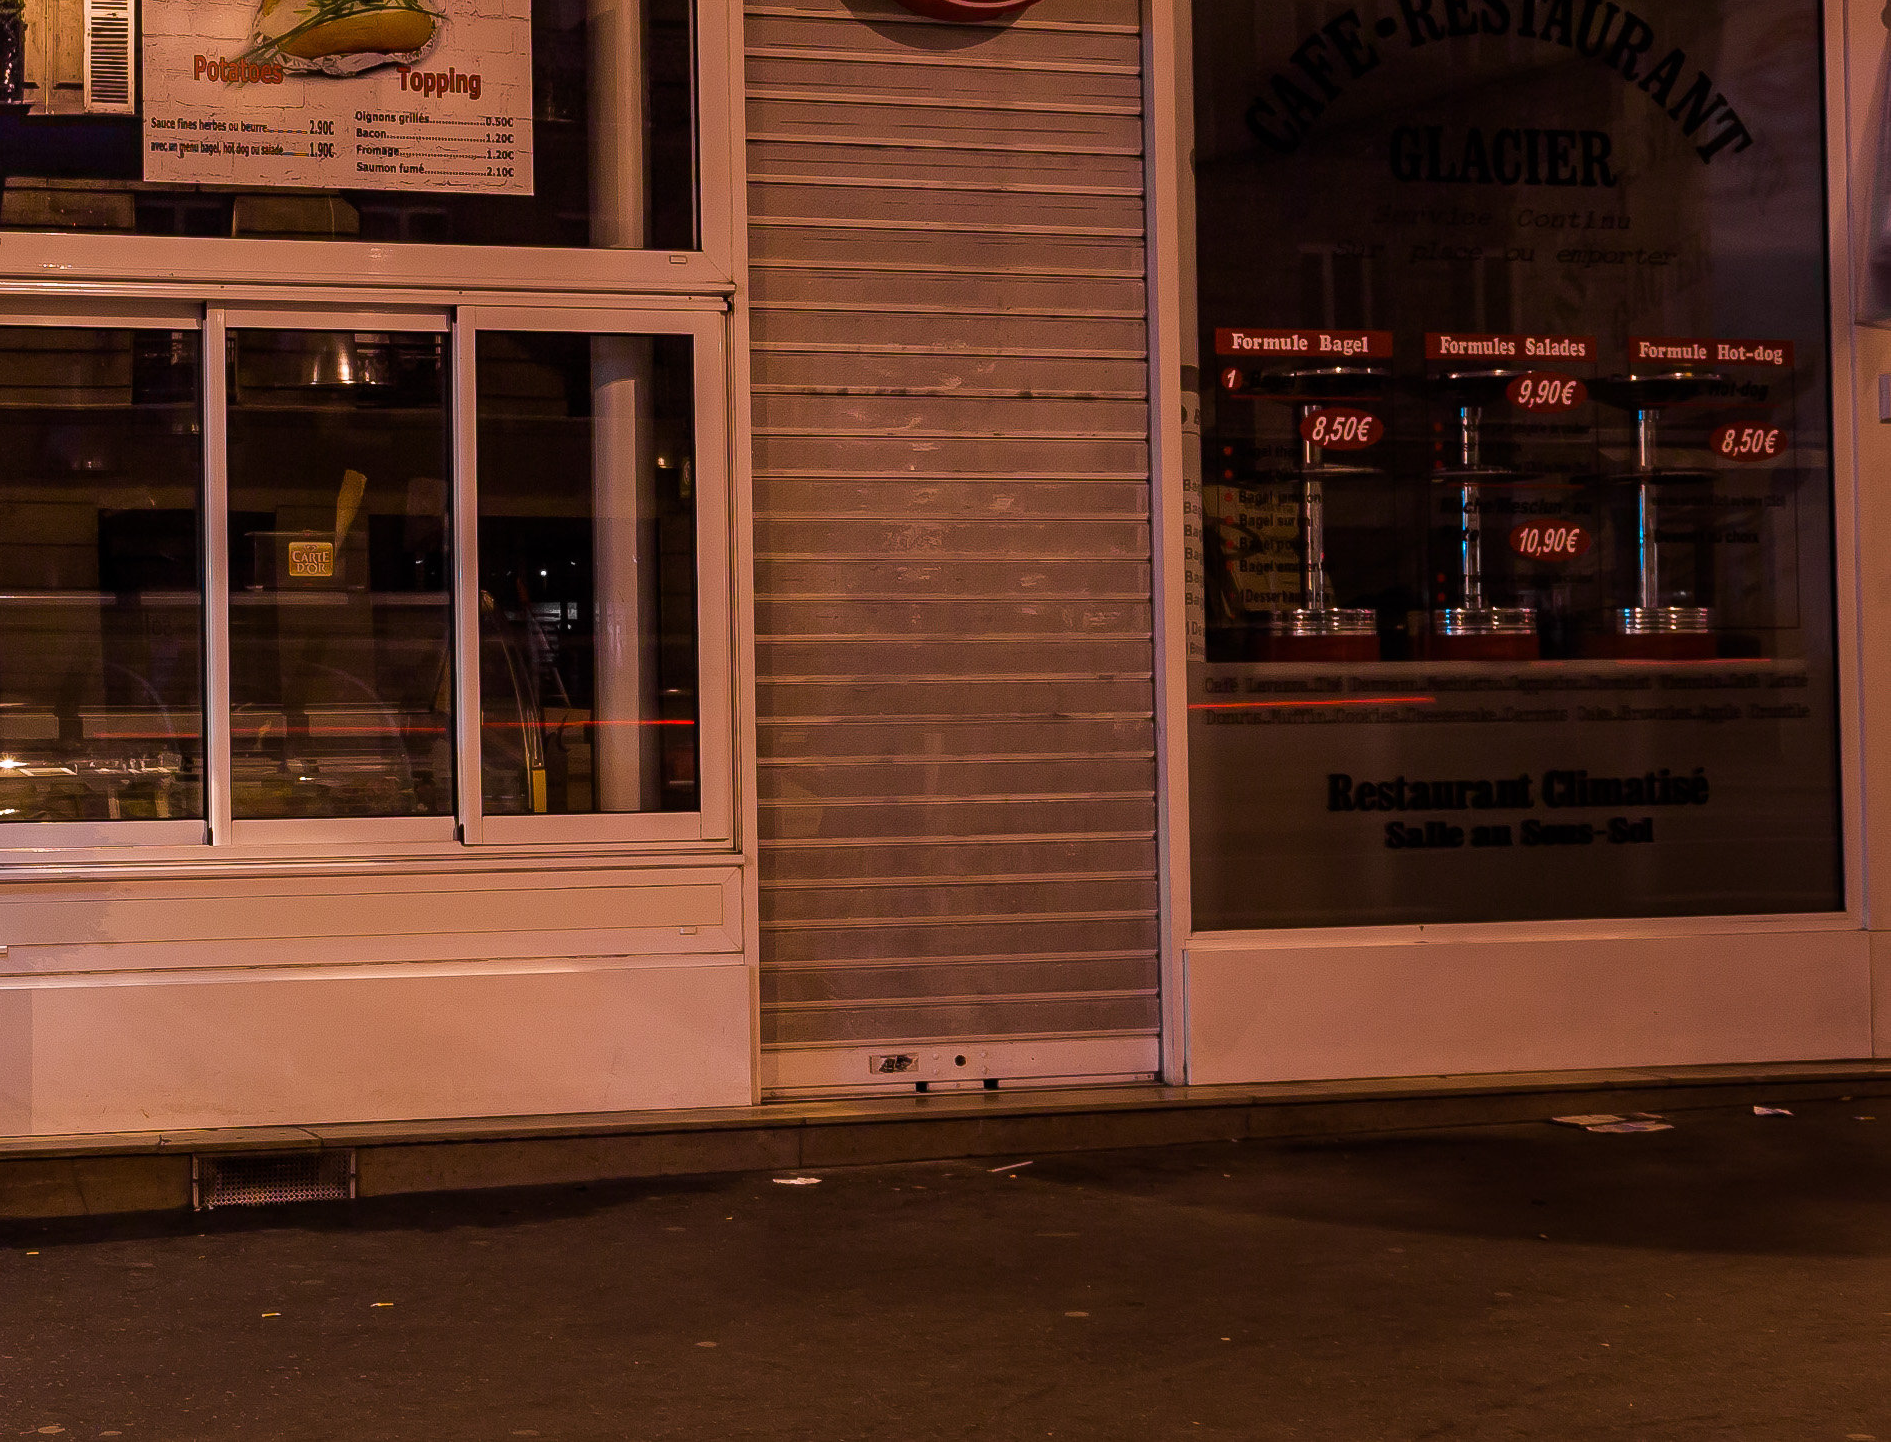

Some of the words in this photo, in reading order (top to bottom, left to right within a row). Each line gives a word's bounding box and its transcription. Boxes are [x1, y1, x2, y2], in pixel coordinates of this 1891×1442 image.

[194, 54, 284, 84] Potatoes
[396, 66, 482, 100] Topping
[151, 117, 175, 129] Sauce
[177, 118, 197, 130] fines
[199, 119, 226, 131] herbes
[229, 122, 239, 131] ou
[355, 111, 396, 124] Oignons
[356, 128, 386, 139] Bacon
[357, 145, 399, 157] Fromage
[1389, 125, 1617, 187] GLACIER
[356, 162, 396, 174] Saumon
[1373, 205, 1494, 227] Service
[1517, 208, 1631, 230] Continu
[1409, 239, 1483, 263] place
[1504, 247, 1535, 262] ou
[1555, 246, 1676, 267] emporter
[1232, 333, 1308, 351] Formule
[1319, 335, 1369, 355] Bagel
[1440, 336, 1516, 356] Formules
[1525, 338, 1586, 357] Salades
[1638, 341, 1708, 359] Formule
[1717, 344, 1783, 365] Hot-dog
[1227, 369, 1236, 388] 1
[1518, 379, 1578, 408] 9,90€
[1709, 381, 1769, 401] Hot-dog
[1311, 416, 1373, 445] 8,50€
[1721, 429, 1779, 457] 8,50€
[1239, 491, 1274, 507] Bagel
[1239, 514, 1274, 530] Bagel
[1519, 527, 1580, 556] 10,90€
[292, 551, 330, 563] CARTE
[1239, 560, 1274, 575] Bagel
[297, 562, 326, 574] D'OR
[1326, 773, 1534, 812] Restaurant
[1542, 767, 1710, 809] Climatisé
[1385, 821, 1465, 849] Salle
[1470, 824, 1513, 848] au
[1519, 817, 1655, 847] Sous-Sol
